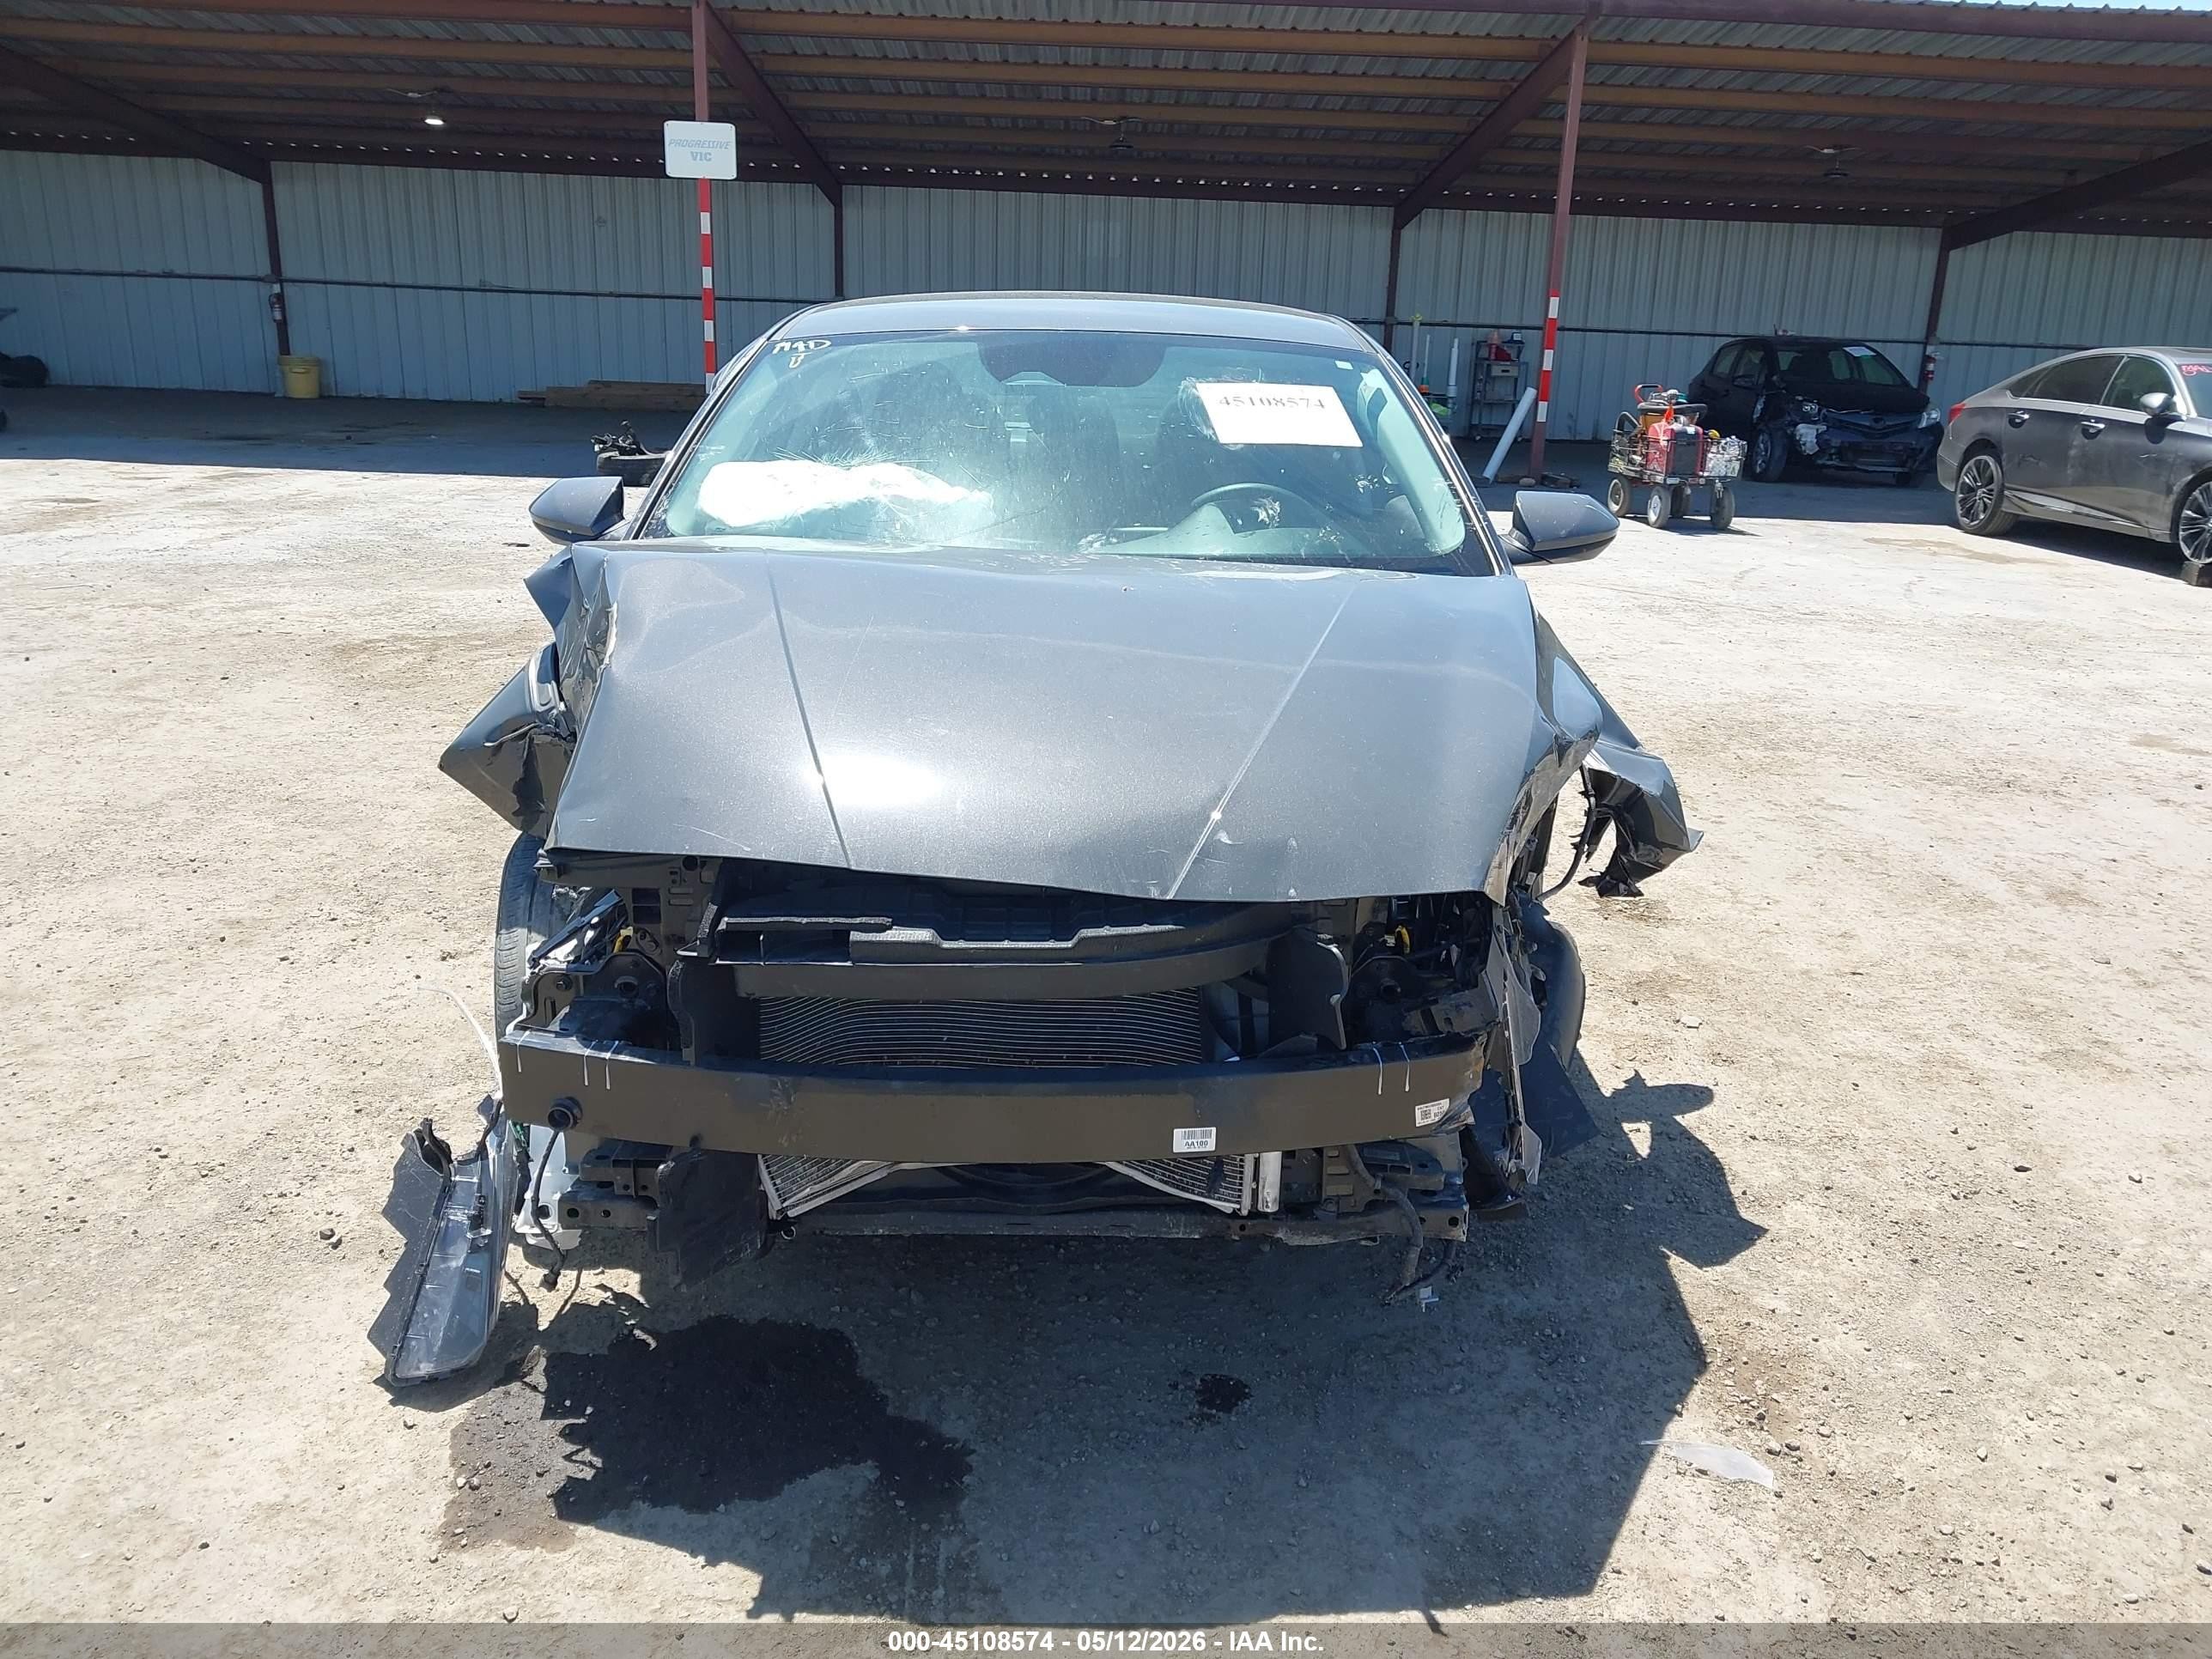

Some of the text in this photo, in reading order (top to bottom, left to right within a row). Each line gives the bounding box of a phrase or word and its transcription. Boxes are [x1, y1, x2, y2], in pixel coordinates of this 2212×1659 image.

[668, 138, 732, 149] PROGRESSIVE
[690, 151, 713, 161] VIC
[1218, 396, 1326, 410] 45108574
